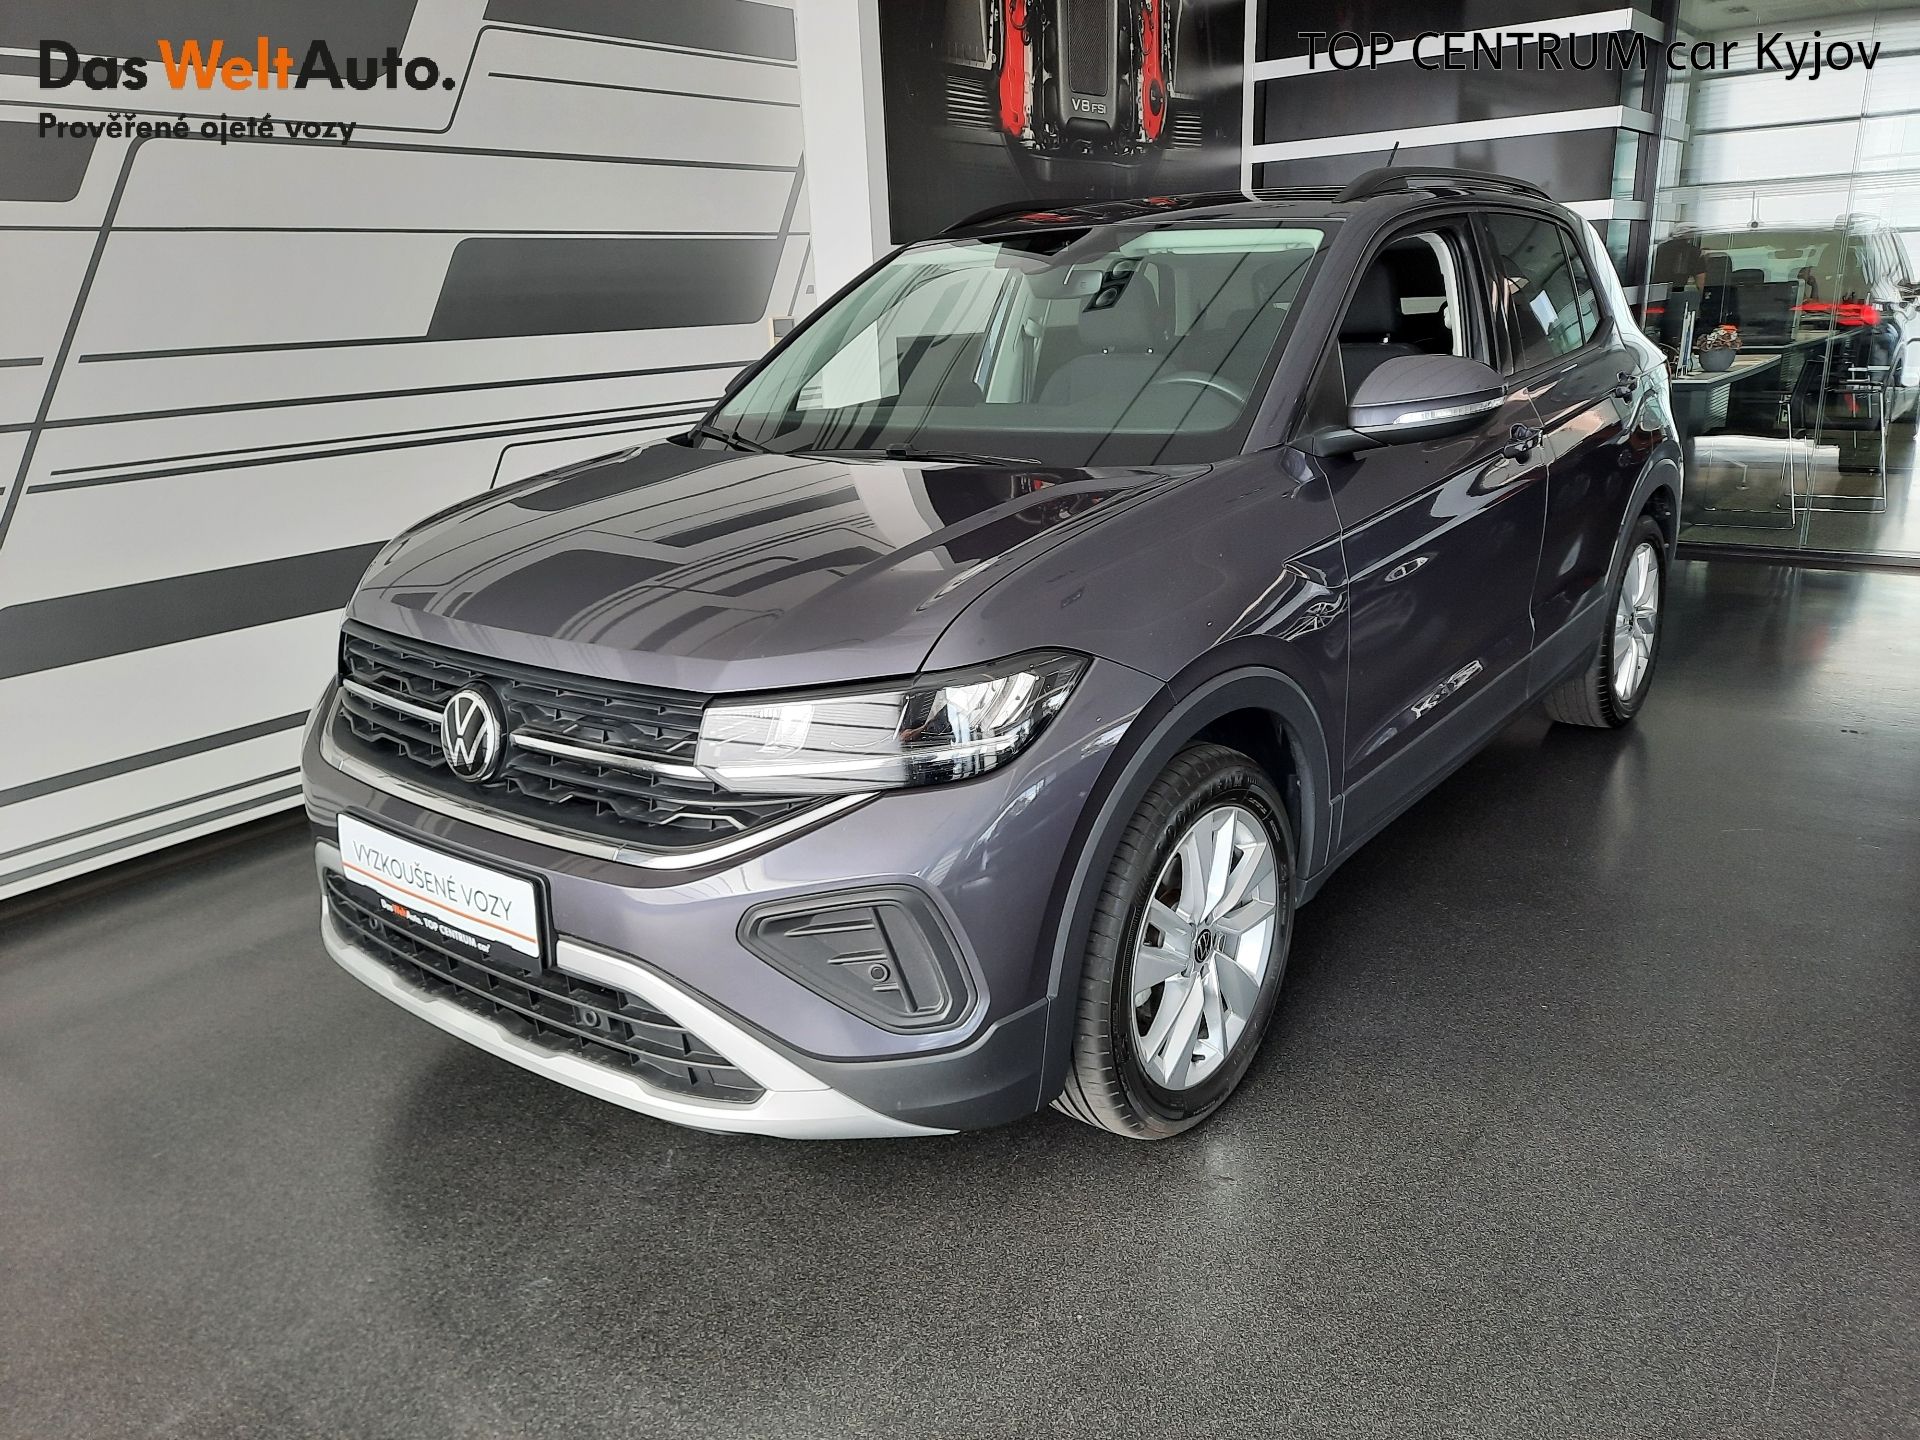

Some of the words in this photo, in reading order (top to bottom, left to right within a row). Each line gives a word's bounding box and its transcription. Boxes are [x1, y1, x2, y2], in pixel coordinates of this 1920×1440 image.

[1072, 99, 1091, 112] V8
[353, 841, 458, 902] VYZKOUŠENÉ
[460, 885, 512, 921] VOZY
